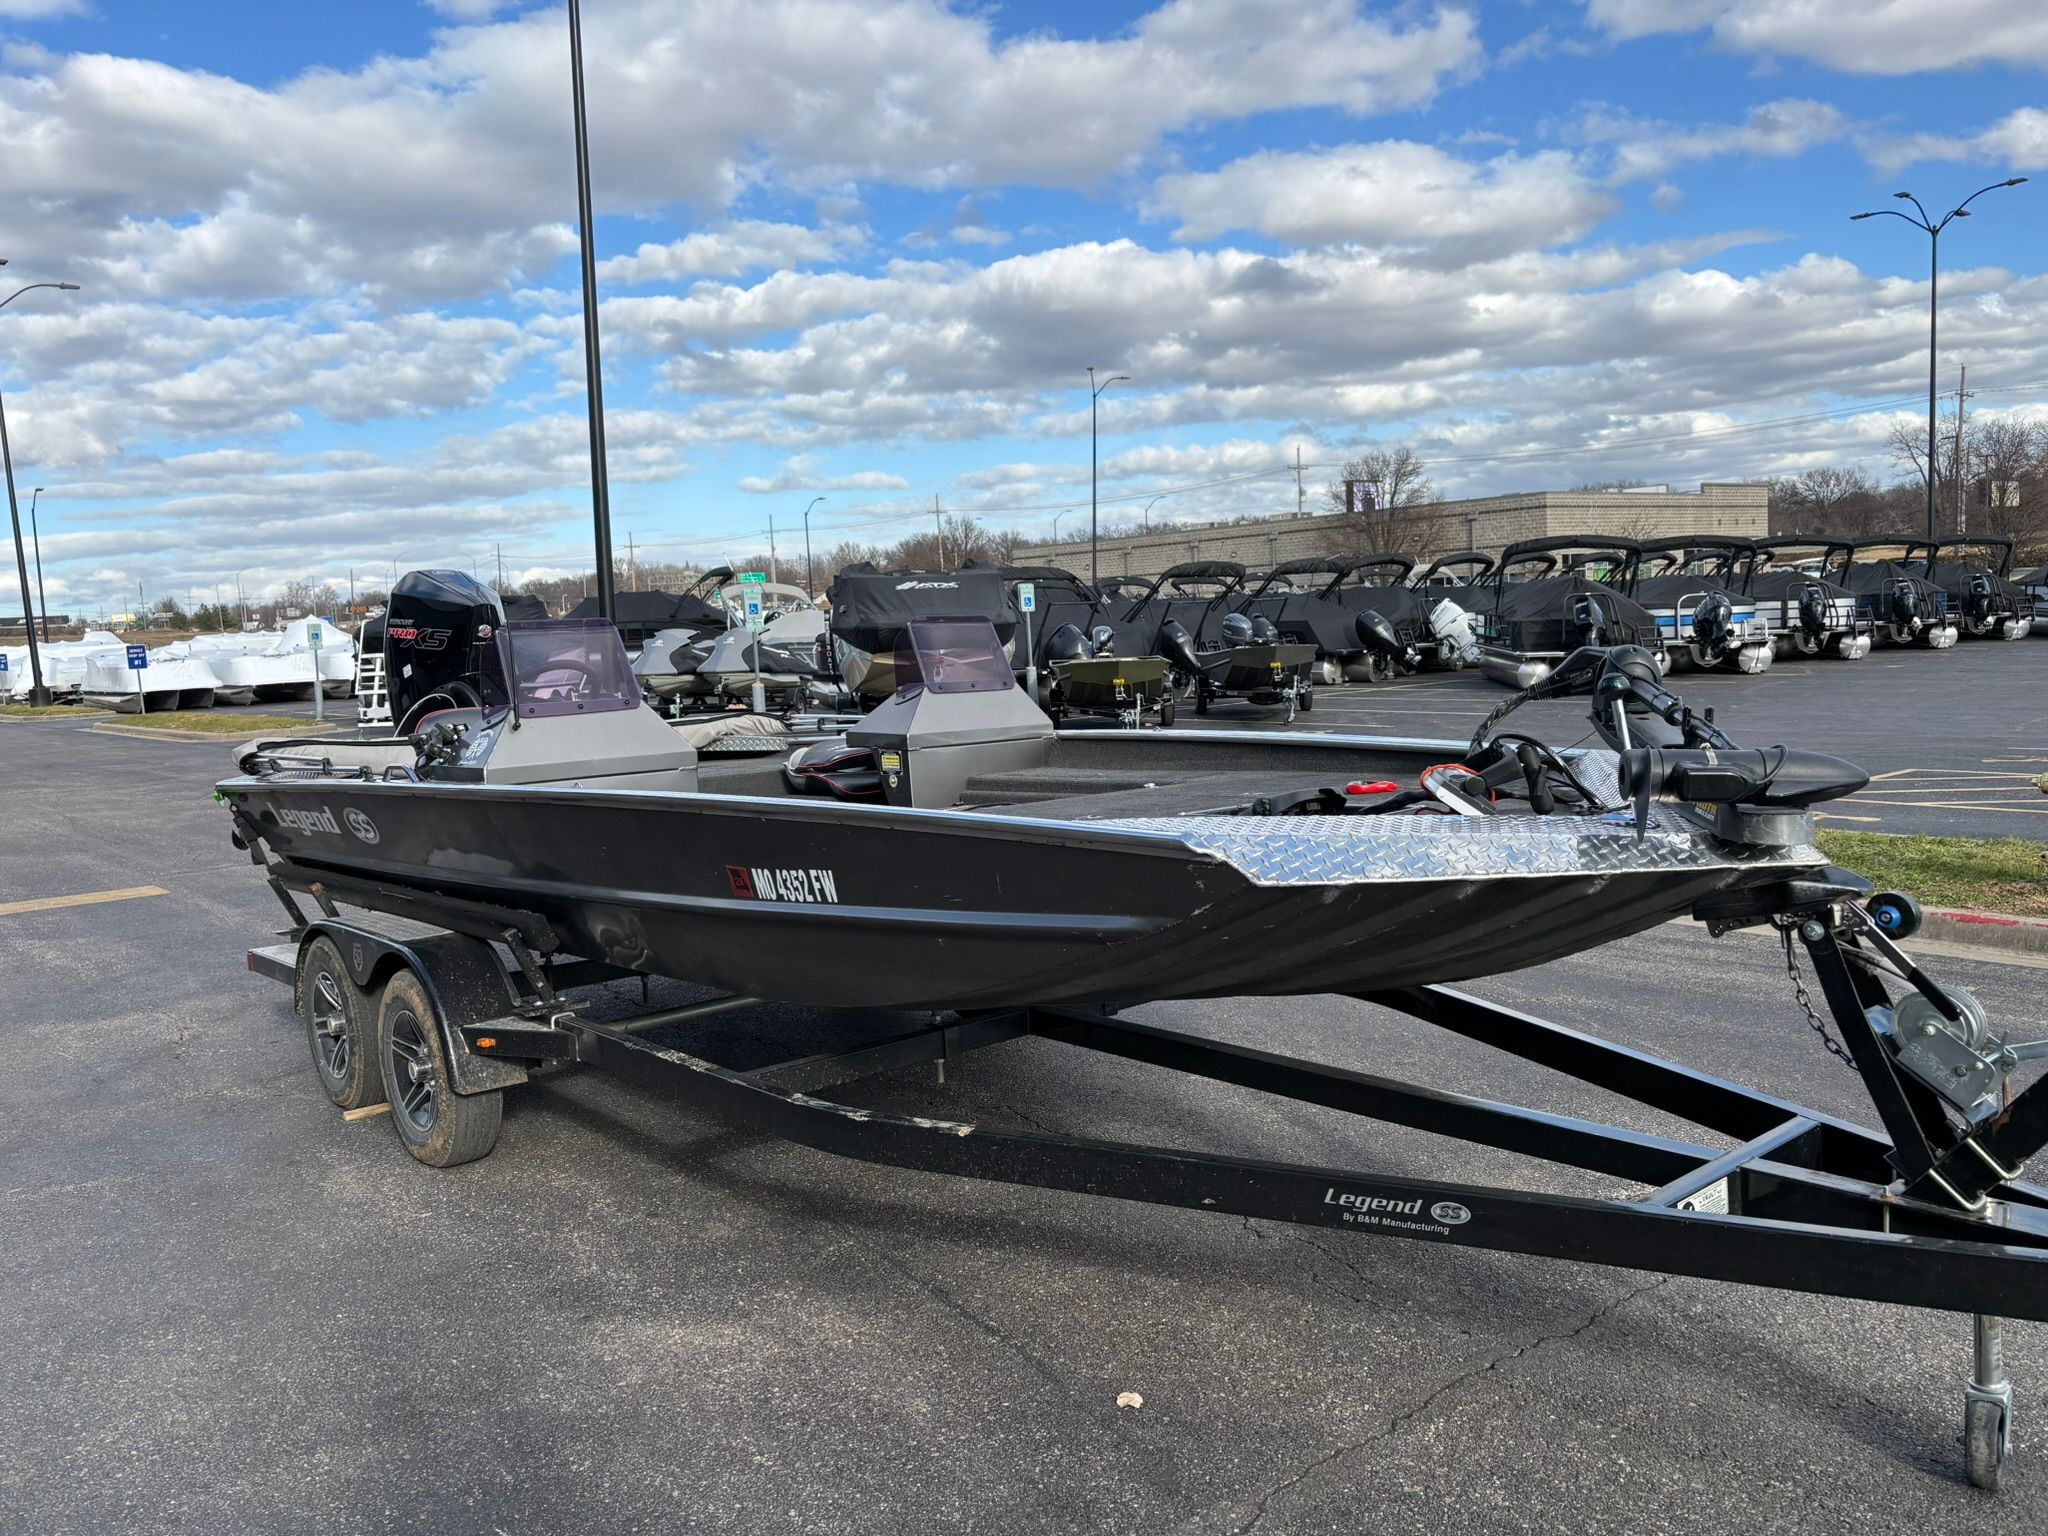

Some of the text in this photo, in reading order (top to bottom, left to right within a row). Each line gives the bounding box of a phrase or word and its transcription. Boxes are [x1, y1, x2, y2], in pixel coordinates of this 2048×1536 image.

[386, 627, 453, 651] PRO XS
[265, 801, 342, 837] Legend
[751, 868, 838, 903] MO 4352 FW
[1324, 1188, 1423, 1216] Legend
[1342, 1213, 1450, 1235] By B&M Manufacturing
